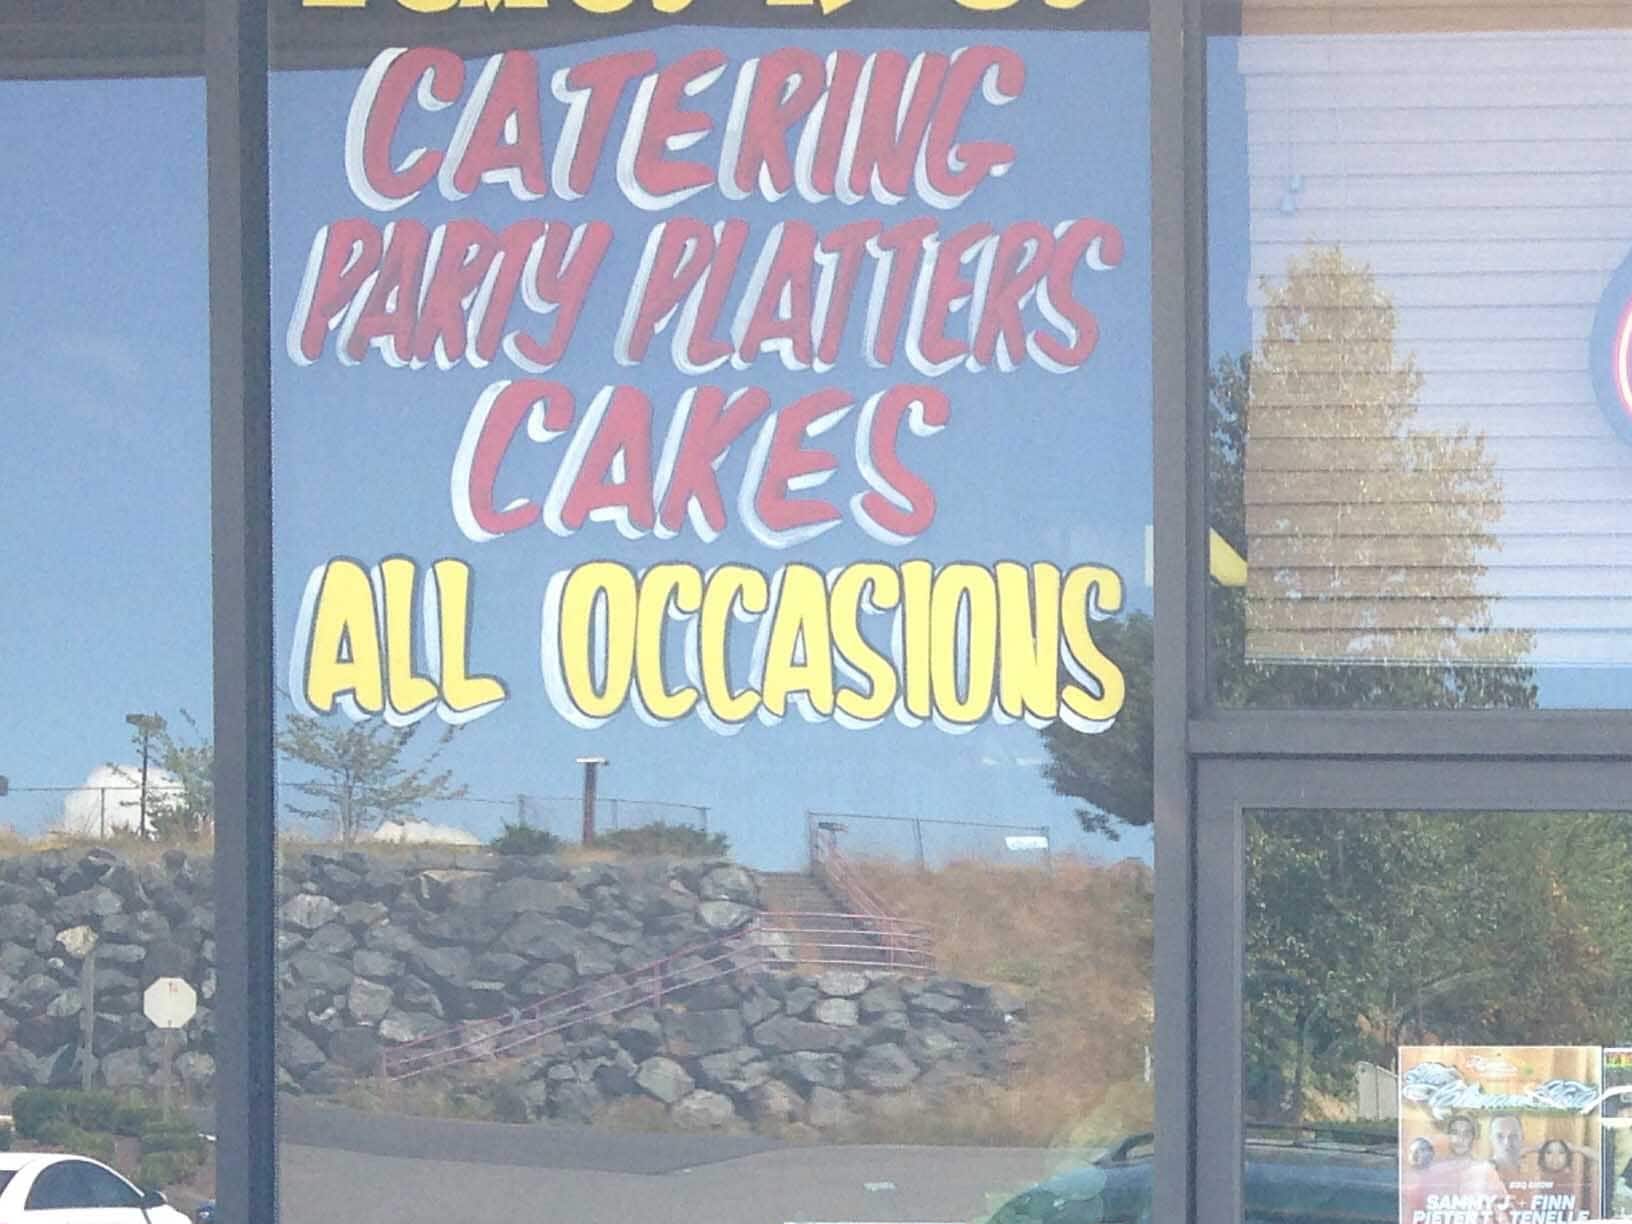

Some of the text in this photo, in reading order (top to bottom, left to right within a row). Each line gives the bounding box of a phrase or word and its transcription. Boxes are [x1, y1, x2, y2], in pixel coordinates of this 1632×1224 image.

[344, 46, 1026, 211] CATERING
[286, 216, 1125, 376] PARTY PLATTERS
[450, 379, 949, 548] CAKES
[290, 556, 1126, 733] ALL OCCASIONS
[1531, 1194, 1576, 1211] FINN
